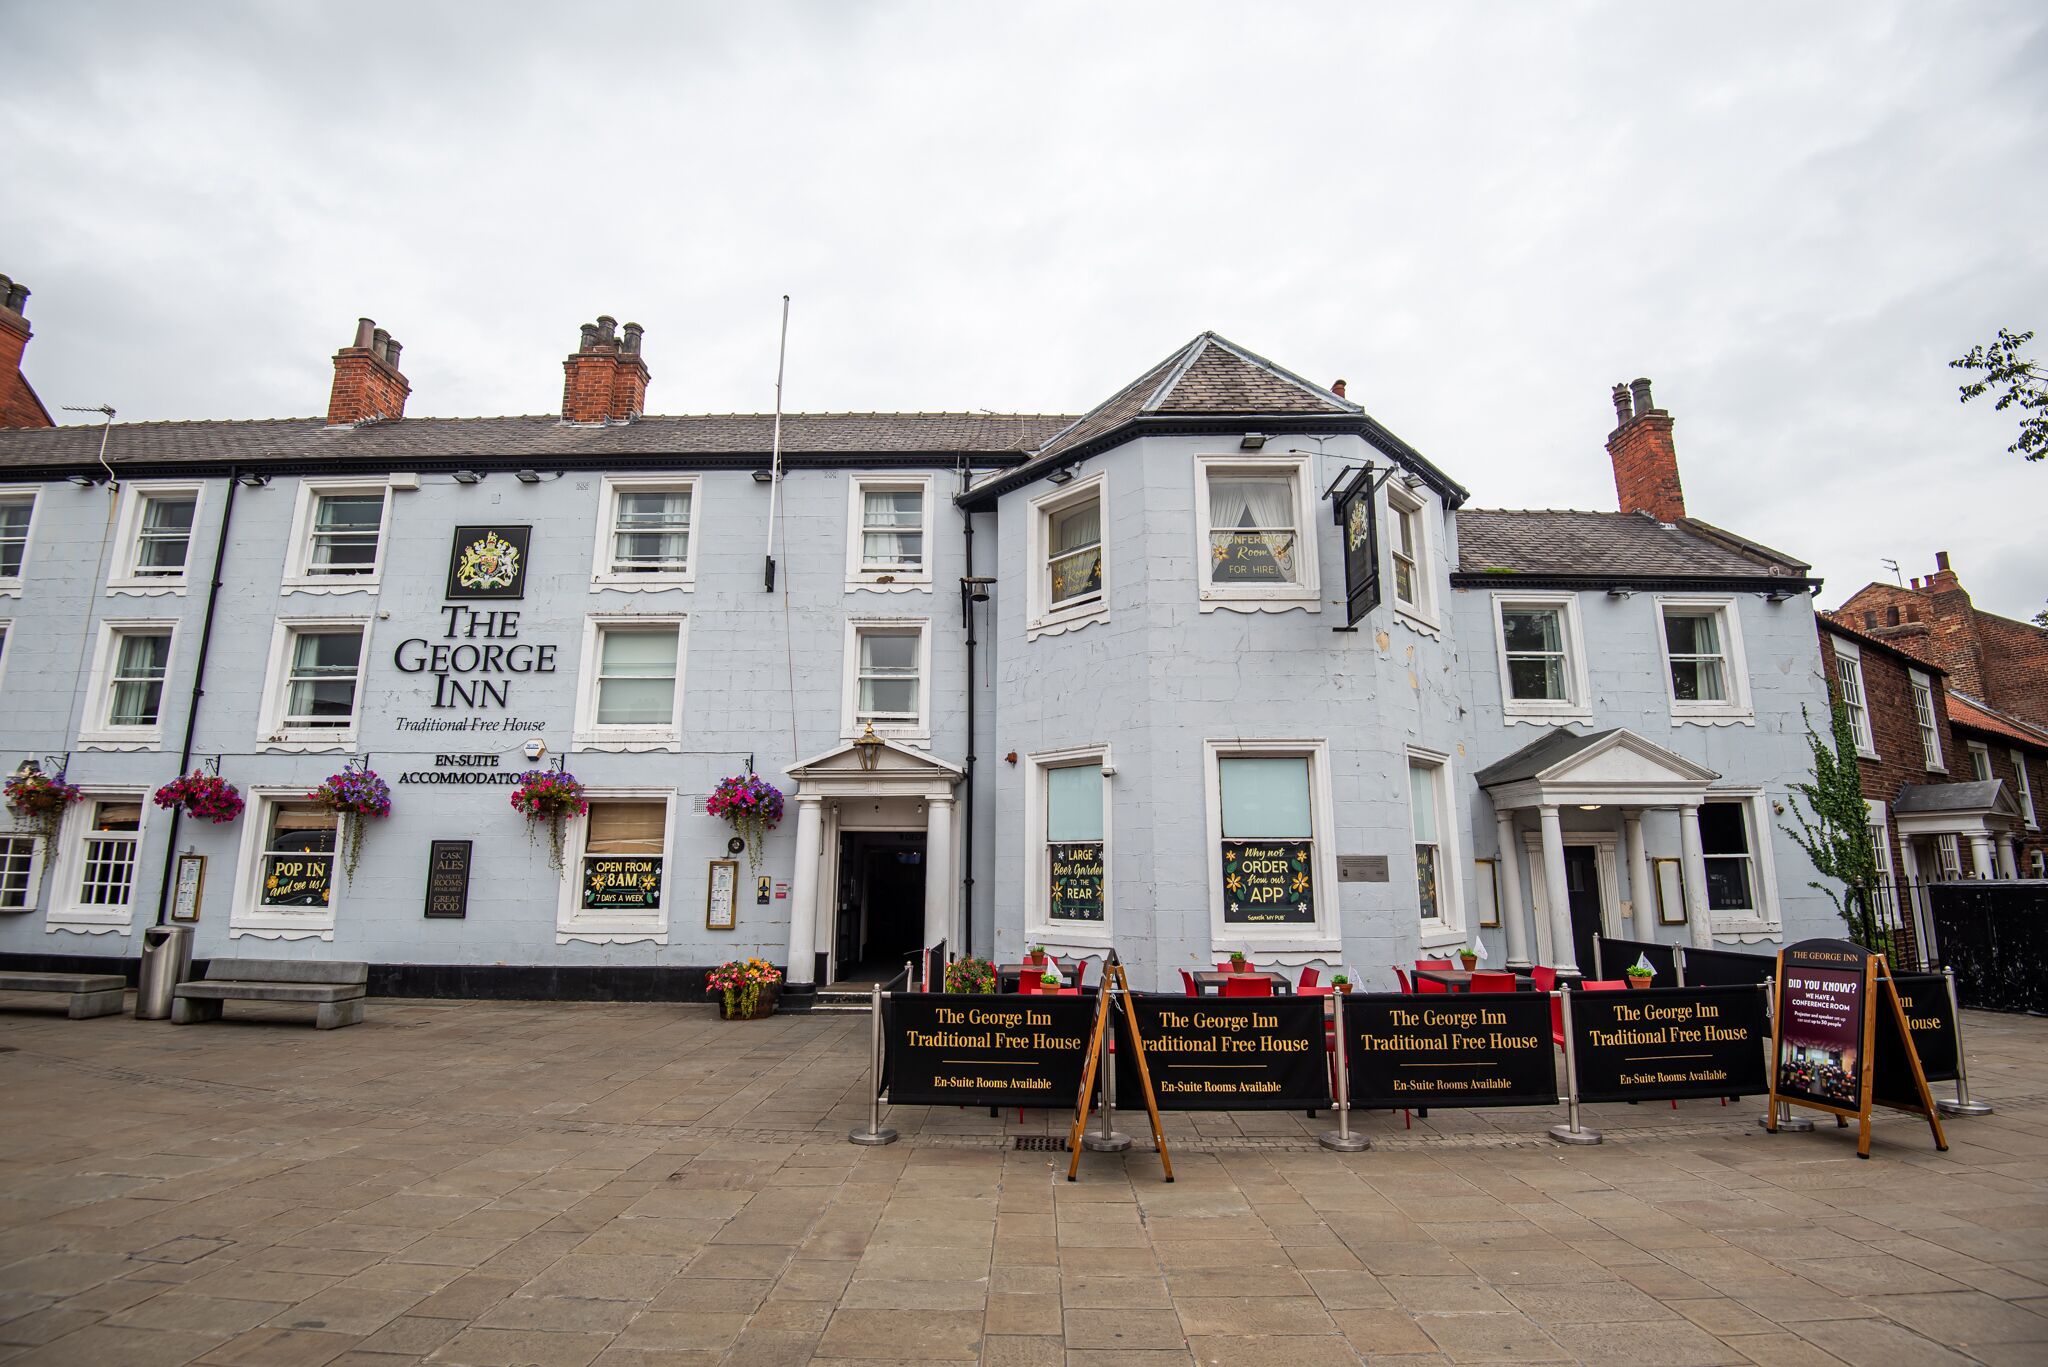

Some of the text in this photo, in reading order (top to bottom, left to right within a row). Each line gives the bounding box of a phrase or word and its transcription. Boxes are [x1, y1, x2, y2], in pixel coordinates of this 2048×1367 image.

[1216, 535, 1288, 544] CONFERENCE
[1237, 546, 1269, 560] Room
[1229, 565, 1279, 574] FOR HIRE!
[441, 605, 520, 638] THE
[394, 638, 557, 673] GEORGE
[431, 673, 511, 708] INN
[396, 717, 546, 731] Traditional Free House
[434, 754, 500, 767] EN-SUITE
[398, 772, 521, 785] ACCOMMODATIO
[440, 851, 462, 860] CASK
[1068, 849, 1093, 860] LARGE
[1244, 847, 1285, 860] Why not
[275, 862, 326, 877] POP IN
[437, 860, 464, 870] ALES
[596, 862, 652, 872] OPEN FROM
[1053, 862, 1072, 876] Beer
[1242, 860, 1288, 873] ORDER
[434, 879, 463, 887] ROOMS
[607, 873, 637, 887] 8AM
[1246, 873, 1286, 886] from our
[270, 878, 326, 897] and see us!
[1067, 888, 1092, 899] REAR
[433, 895, 460, 903] GREAT
[596, 894, 644, 902] 7 DAYS A WEEK
[1250, 887, 1284, 903] APP
[433, 902, 459, 911] FOOD
[1793, 951, 1858, 962] THE GEORGE INN
[1788, 979, 1857, 994] DID YOU KNOW?
[1814, 993, 1829, 1001] HAVE
[1899, 996, 1913, 1008] nn
[1792, 999, 1850, 1011] CONFERENCE ROOM
[936, 1008, 1052, 1028] The George Inn
[1613, 1002, 1719, 1022] The George Inn
[1159, 1012, 1279, 1031] The George Inn
[1390, 1009, 1507, 1029] The George Inn
[907, 1030, 1081, 1050] Traditional Free House
[1361, 1033, 1538, 1050] Traditional Free House
[1590, 1025, 1748, 1047] Traditional Free House
[1140, 1035, 1309, 1052] raditional Free House
[934, 1076, 1052, 1089] En-Suite Rooms Available
[1620, 1070, 1727, 1085] En-Suite Rooms Available
[1161, 1081, 1282, 1092] En-Suite Rooms Available
[1393, 1078, 1512, 1091] En-Suite Rooms Available
